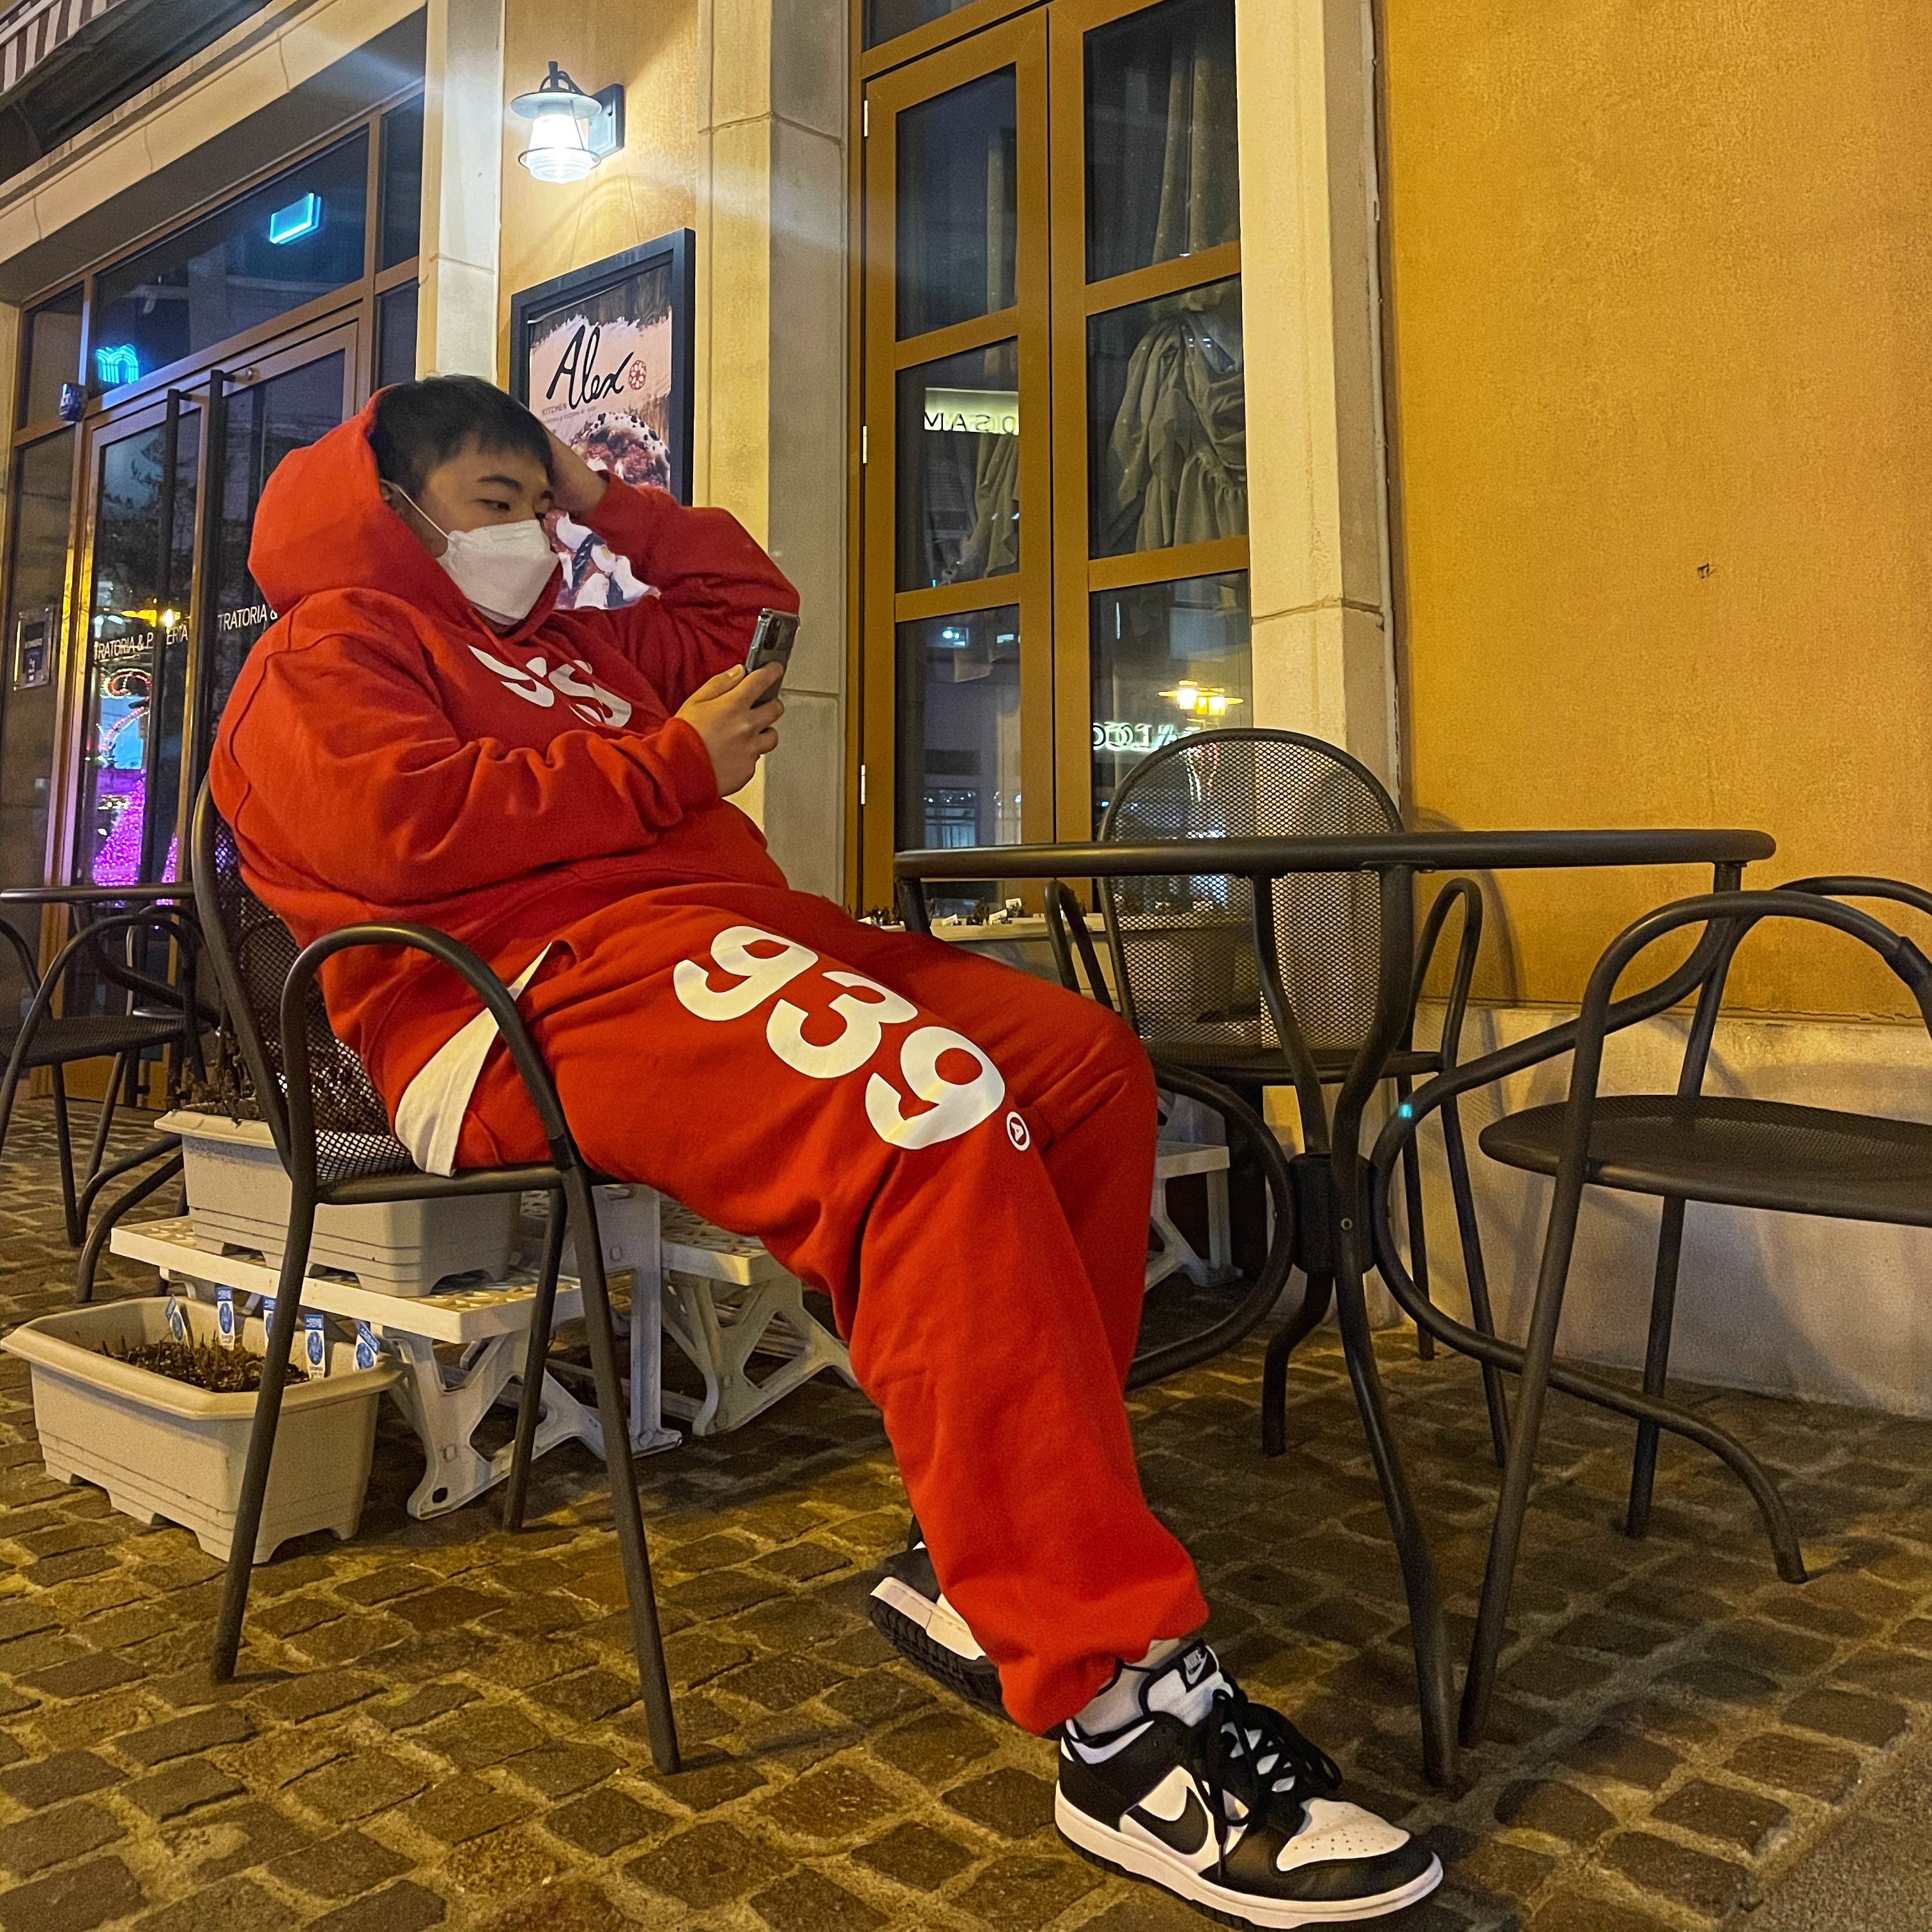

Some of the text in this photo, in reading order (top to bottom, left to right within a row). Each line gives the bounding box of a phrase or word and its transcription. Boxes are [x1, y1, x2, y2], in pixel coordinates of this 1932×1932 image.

[546, 325, 634, 410] Alex
[218, 604, 267, 632] TRATORIA
[94, 637, 135, 660] TRATORIA
[137, 634, 144, 651] &
[673, 926, 1006, 1149] 939
